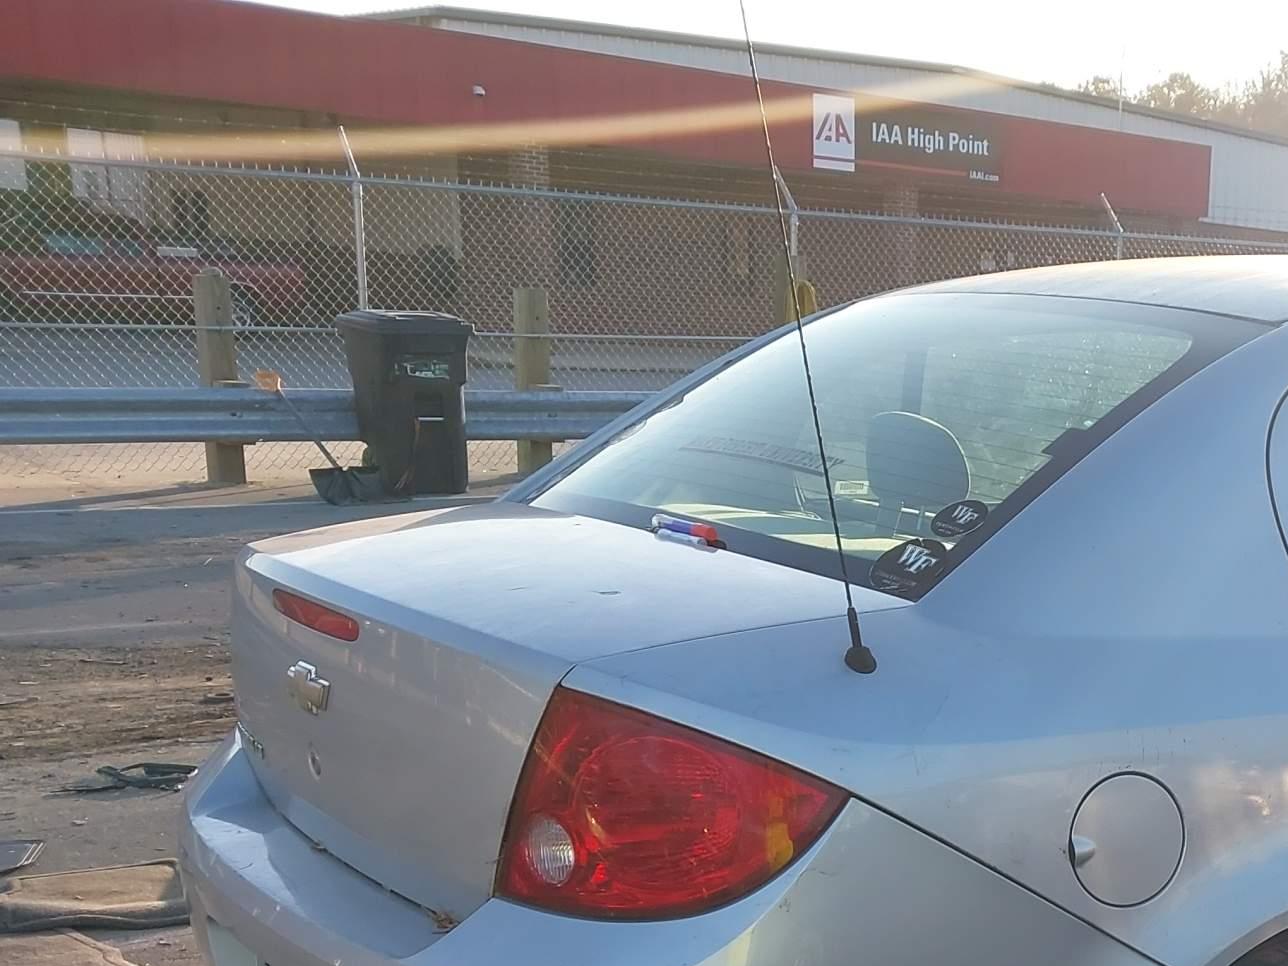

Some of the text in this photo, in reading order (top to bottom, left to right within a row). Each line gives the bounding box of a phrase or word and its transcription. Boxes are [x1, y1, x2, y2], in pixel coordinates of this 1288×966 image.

[872, 121, 990, 156] IAA High Point
[897, 543, 937, 574] WF
